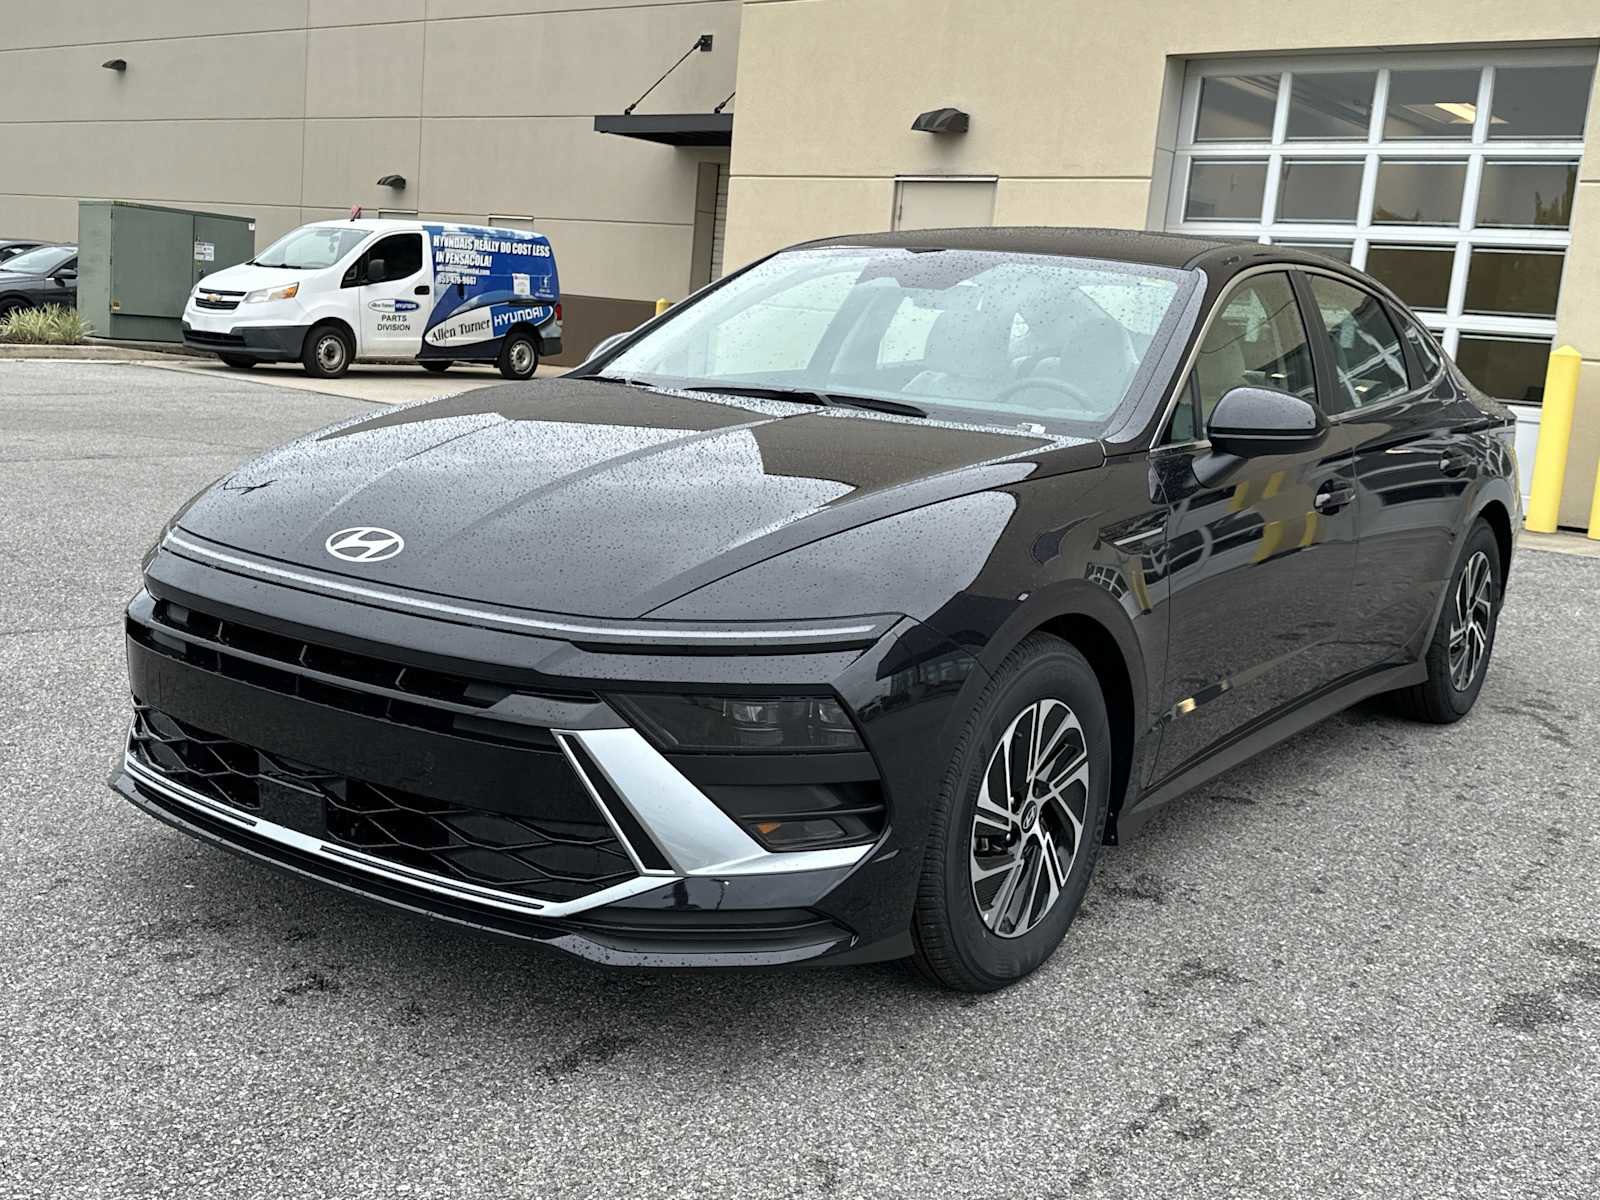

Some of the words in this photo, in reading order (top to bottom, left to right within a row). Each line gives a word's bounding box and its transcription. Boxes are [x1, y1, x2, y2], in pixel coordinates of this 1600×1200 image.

[433, 235, 473, 249] HYUNDAIS
[473, 239, 500, 252] REALLY
[500, 241, 511, 254] DO
[512, 242, 532, 256] COST
[532, 244, 551, 258] LESS
[436, 251, 446, 263] IN
[446, 252, 492, 267] PENSACOLA!
[377, 323, 411, 331] DIVISION
[431, 328, 456, 342] Allen
[458, 319, 490, 335] Turner
[494, 307, 543, 326] HYUNDAI
